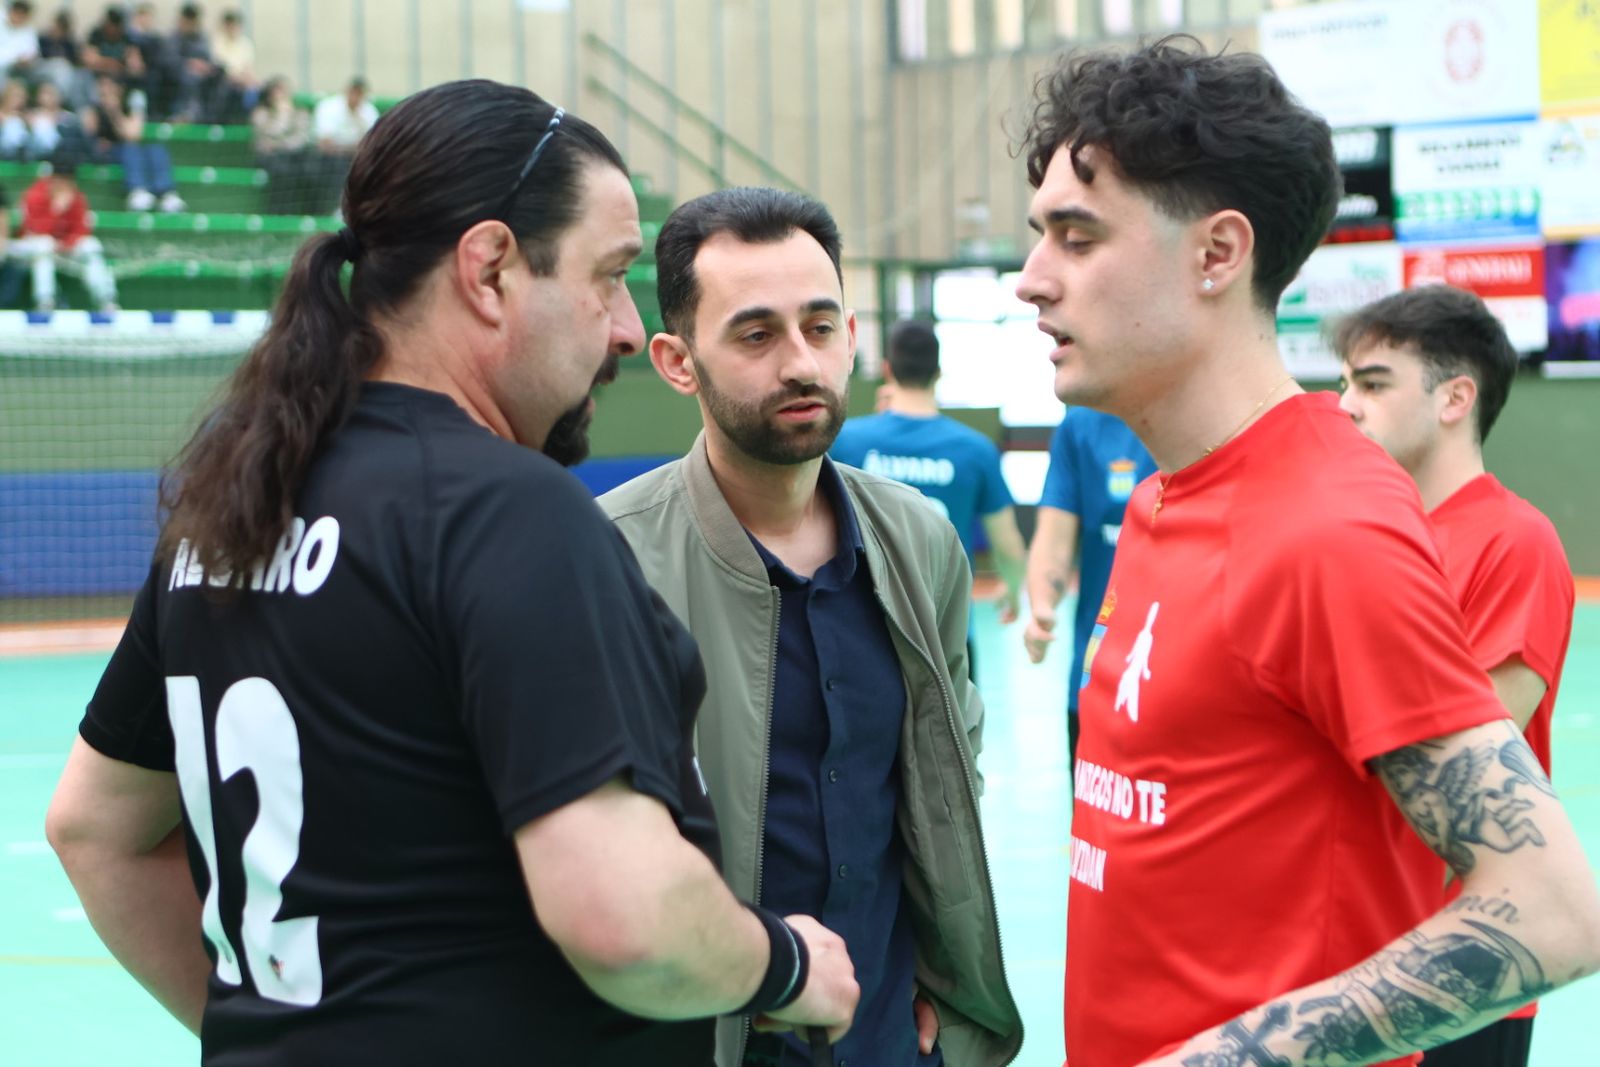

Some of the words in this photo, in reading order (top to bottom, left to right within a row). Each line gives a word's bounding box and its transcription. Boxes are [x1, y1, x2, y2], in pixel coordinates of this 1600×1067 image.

[164, 675, 323, 1007] 12
[1111, 771, 1134, 820] NO
[1136, 779, 1167, 825] TE
